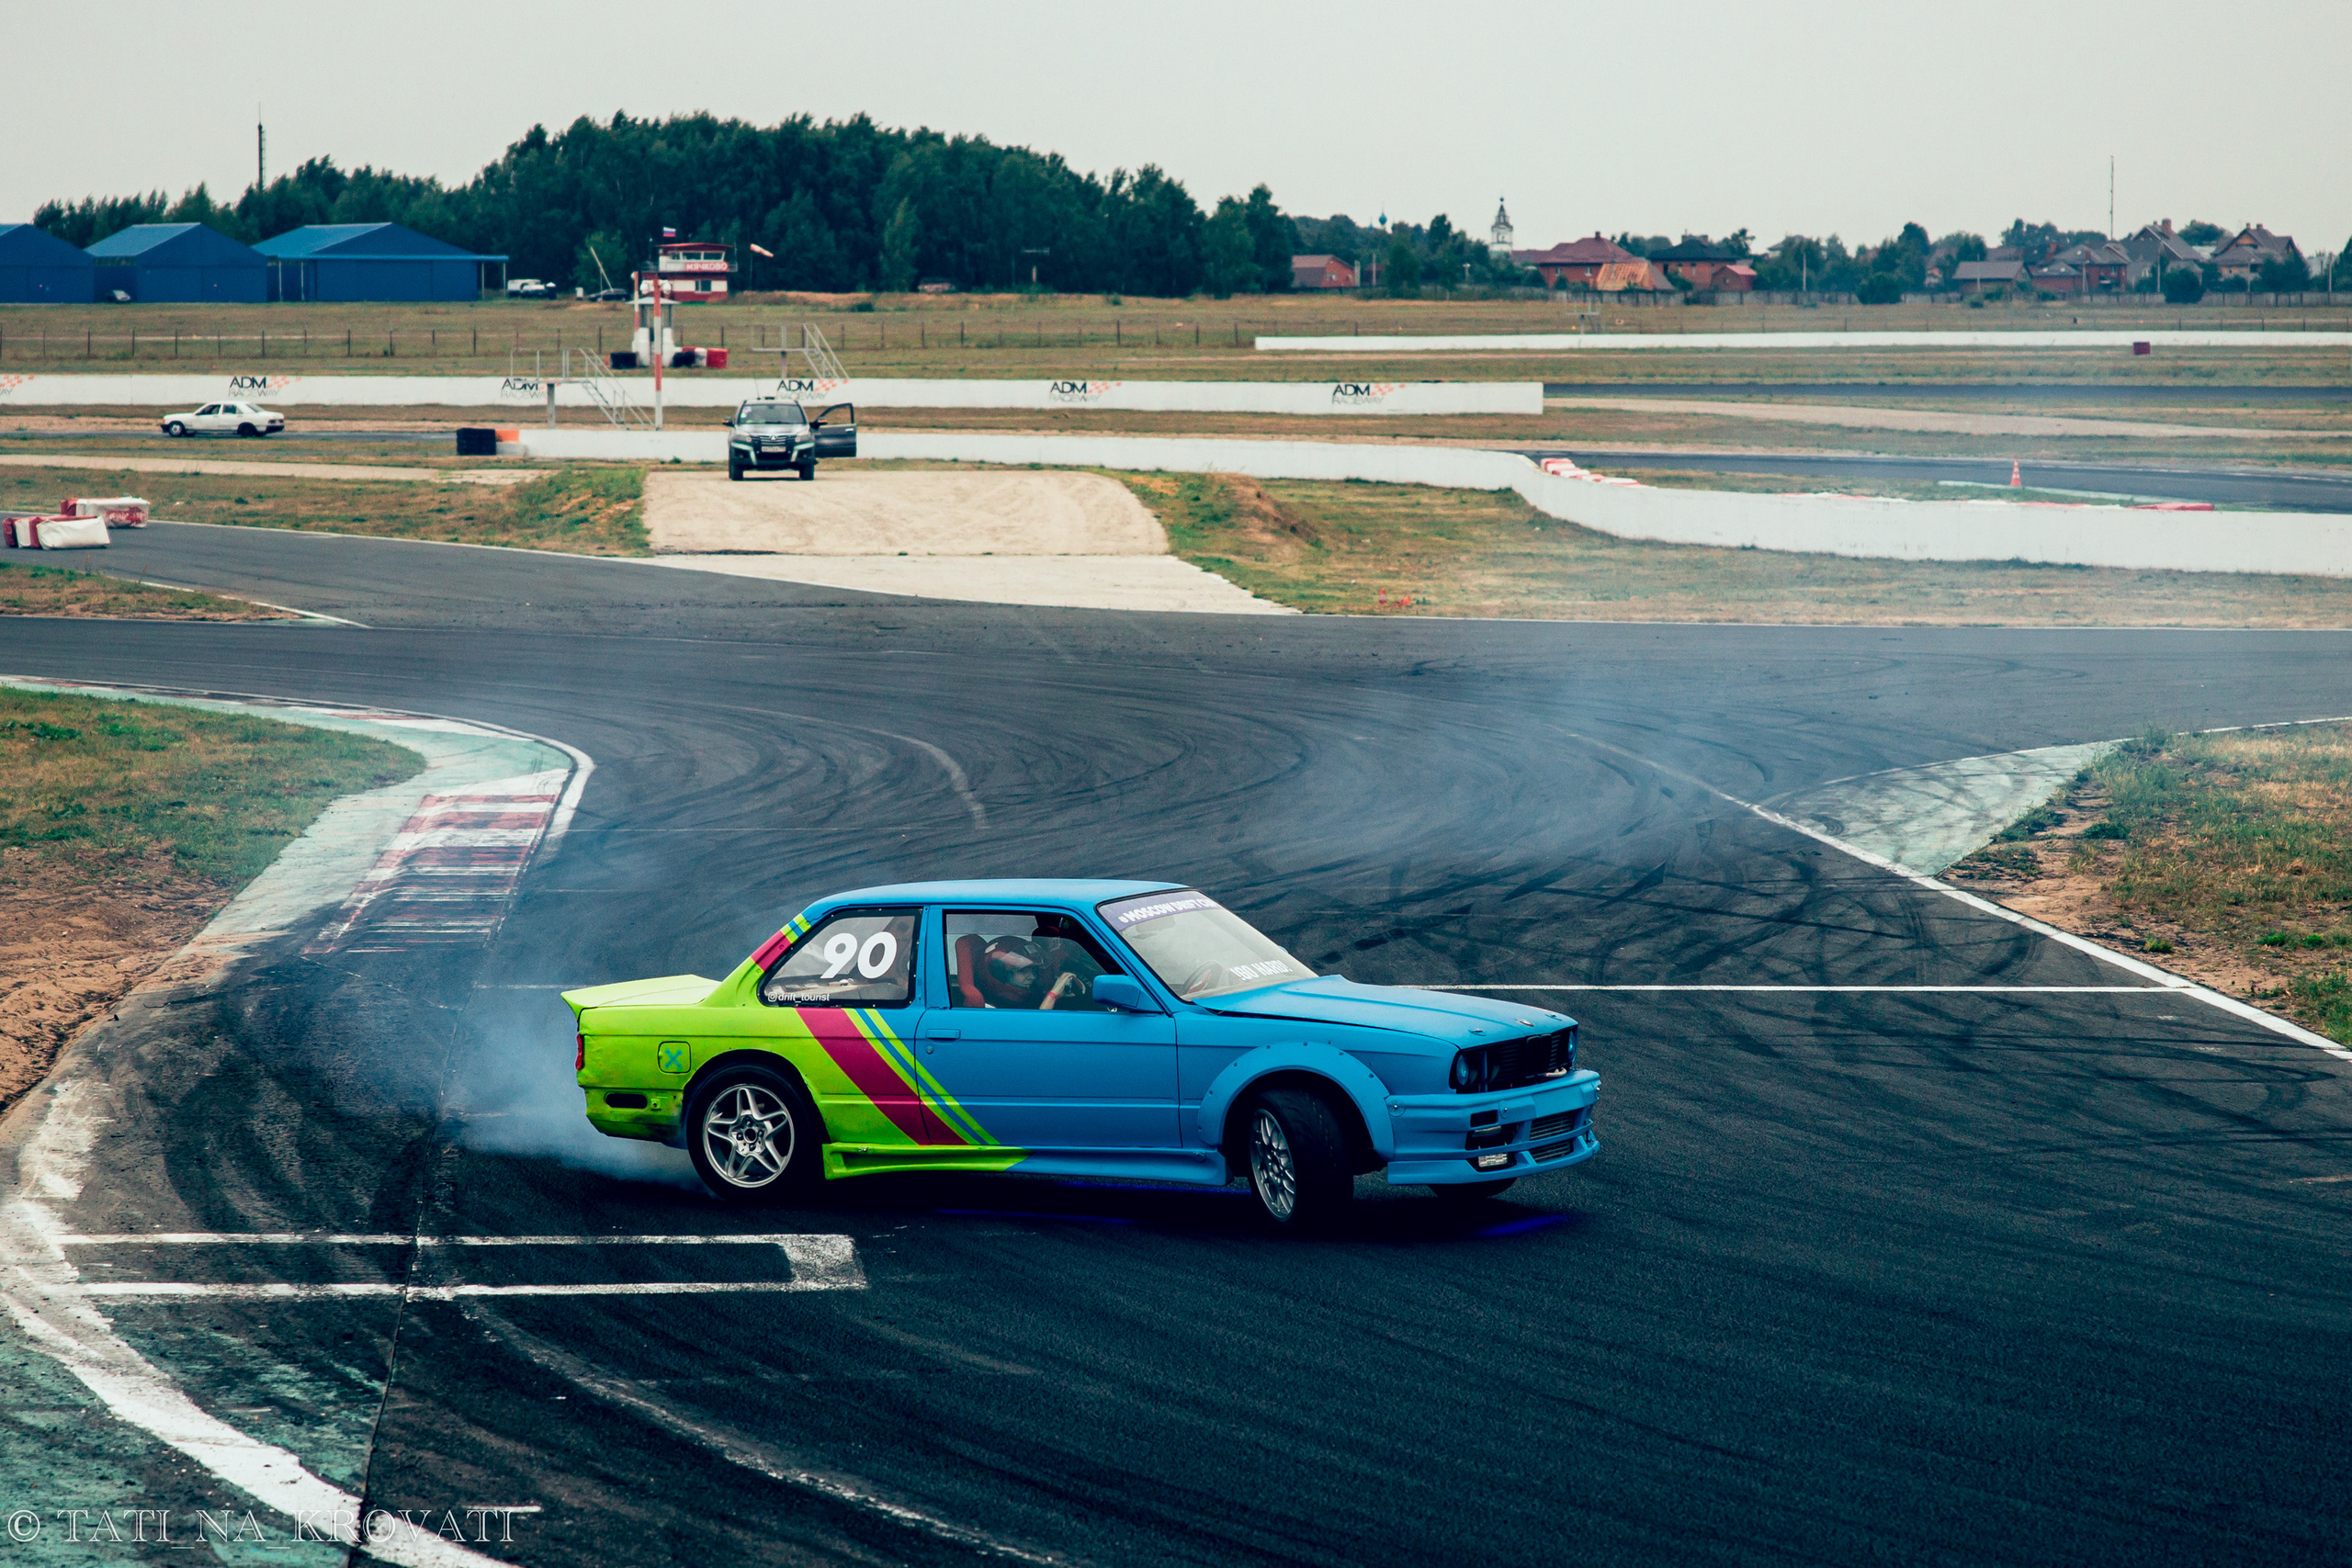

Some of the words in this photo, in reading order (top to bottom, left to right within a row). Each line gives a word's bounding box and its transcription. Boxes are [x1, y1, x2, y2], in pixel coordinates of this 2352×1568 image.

[229, 376, 266, 389] ADM
[502, 378, 538, 390] ADM
[777, 379, 813, 391] ADM
[1050, 381, 1087, 394] ADM
[229, 389, 279, 397] RACEWAY
[501, 390, 548, 399] RACEWA
[1332, 384, 1370, 396] ADM
[1332, 396, 1384, 404] RACEWAY
[1123, 902, 1176, 921] MOSCOW
[1172, 898, 1203, 911] DRIFT
[820, 931, 898, 979] 90
[778, 992, 830, 1003] drift_tourist
